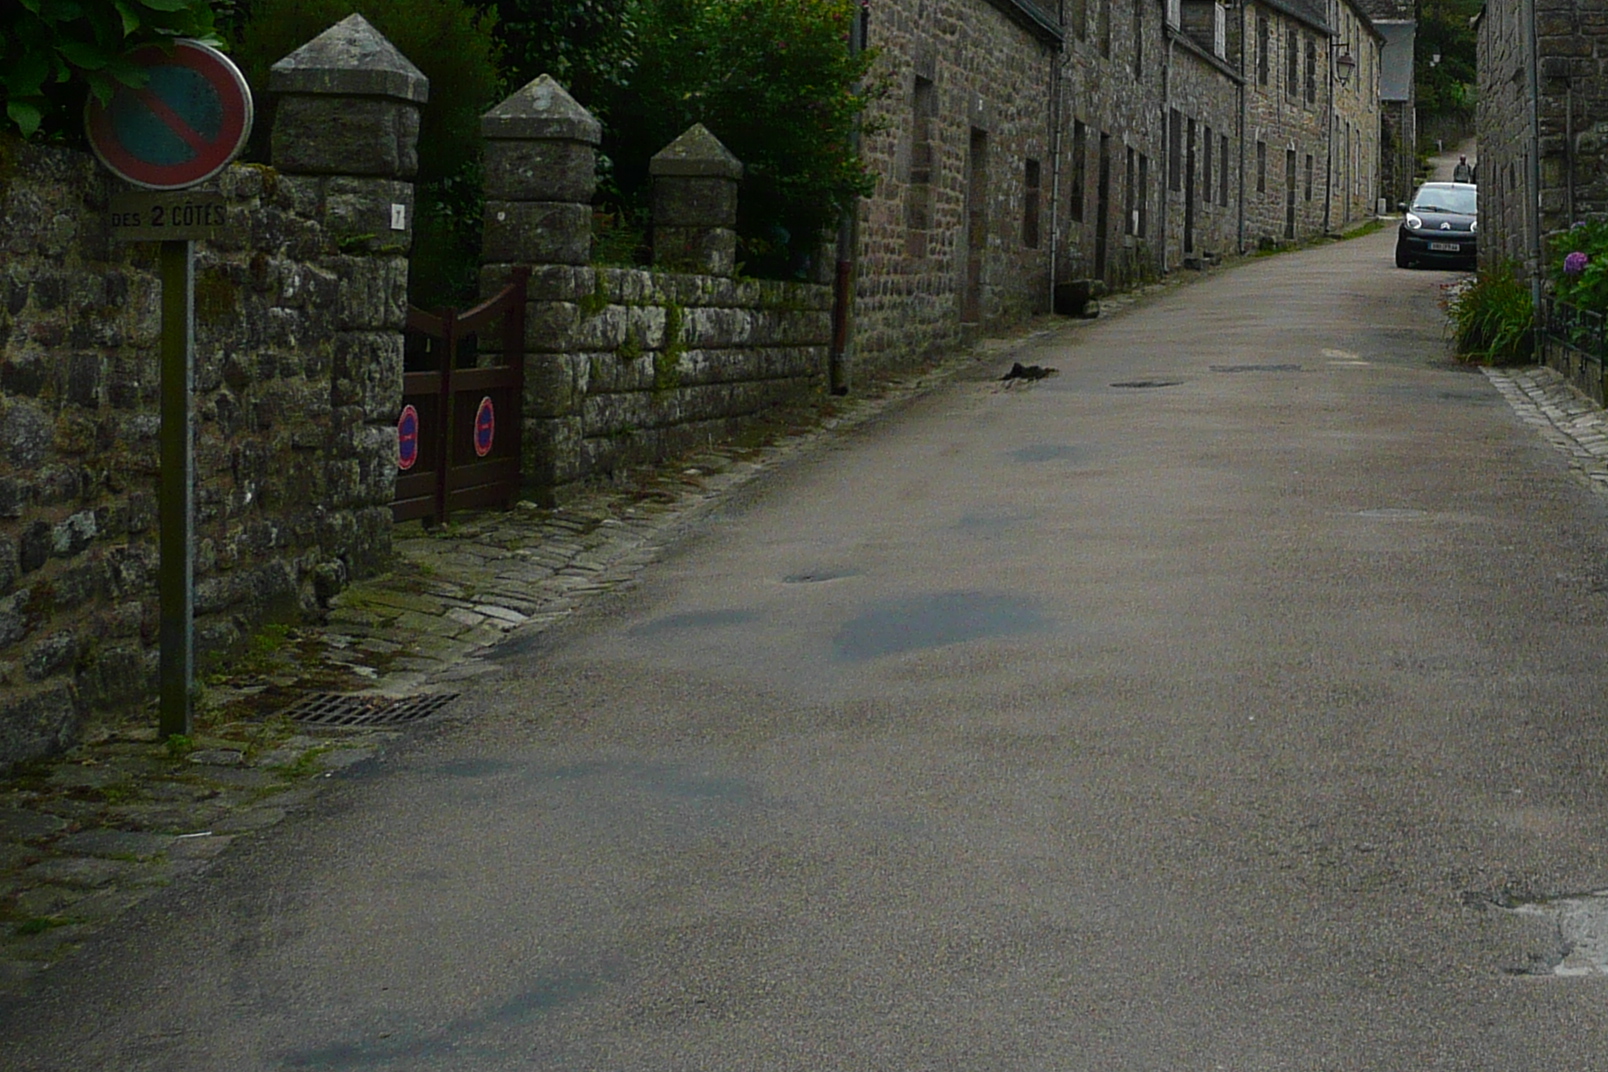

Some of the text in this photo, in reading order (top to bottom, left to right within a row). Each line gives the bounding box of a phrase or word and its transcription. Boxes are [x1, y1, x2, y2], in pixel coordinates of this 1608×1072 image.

[112, 201, 227, 227] DES 2 CÔTÉS
